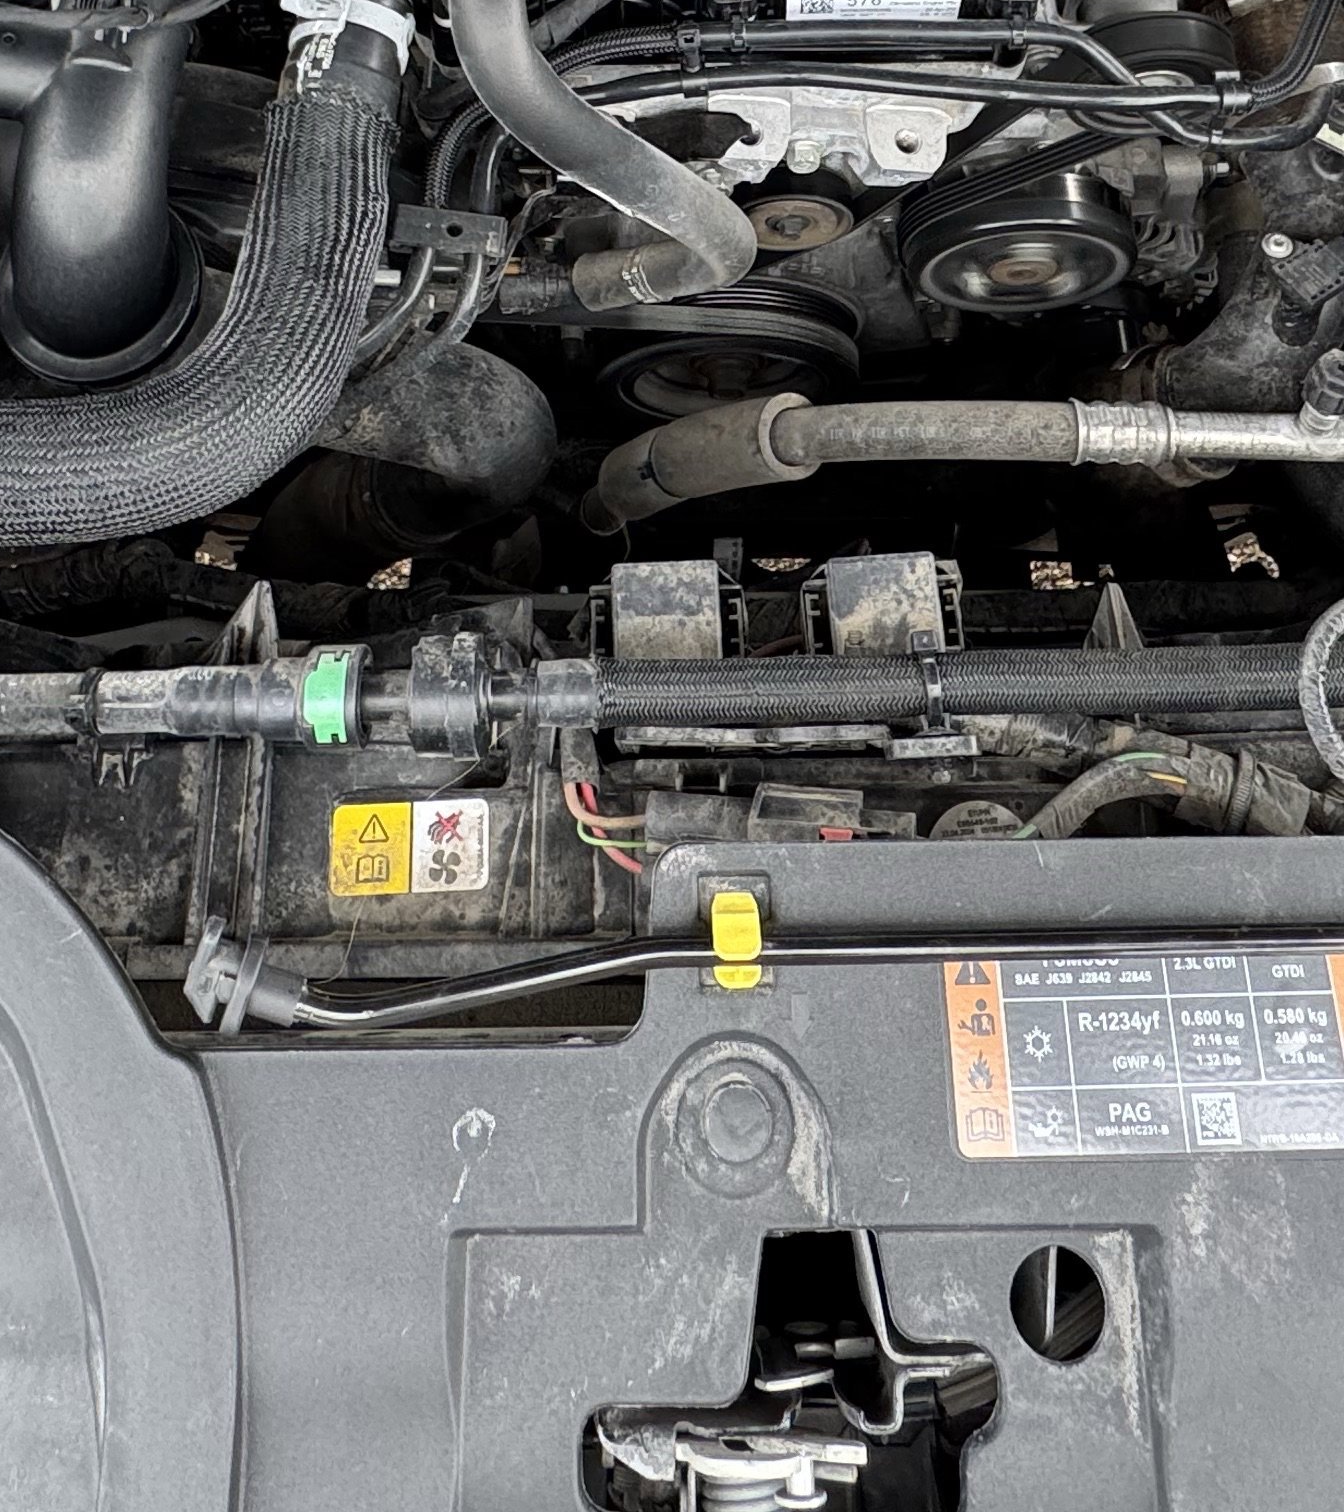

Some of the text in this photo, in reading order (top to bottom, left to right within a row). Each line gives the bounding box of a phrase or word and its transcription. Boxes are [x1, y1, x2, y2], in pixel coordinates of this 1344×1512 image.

[1173, 956, 1237, 971] 2.3L GTDI
[1014, 970, 1153, 985] SAE J639 J2842 J2845
[1271, 965, 1305, 978] GTDI
[1078, 1010, 1160, 1035] R-1234yf
[1180, 1009, 1245, 1029] 0.600 kg
[1263, 1007, 1328, 1027] 0.580 kg
[1192, 1033, 1240, 1047] 21.16 oz
[1309, 1032, 1324, 1044] oz
[1112, 1052, 1166, 1073] (GWP 4)
[1196, 1053, 1242, 1066] 1.32 lbs
[1279, 1050, 1326, 1065] 1.28 lbs
[1108, 1102, 1152, 1123] PAG
